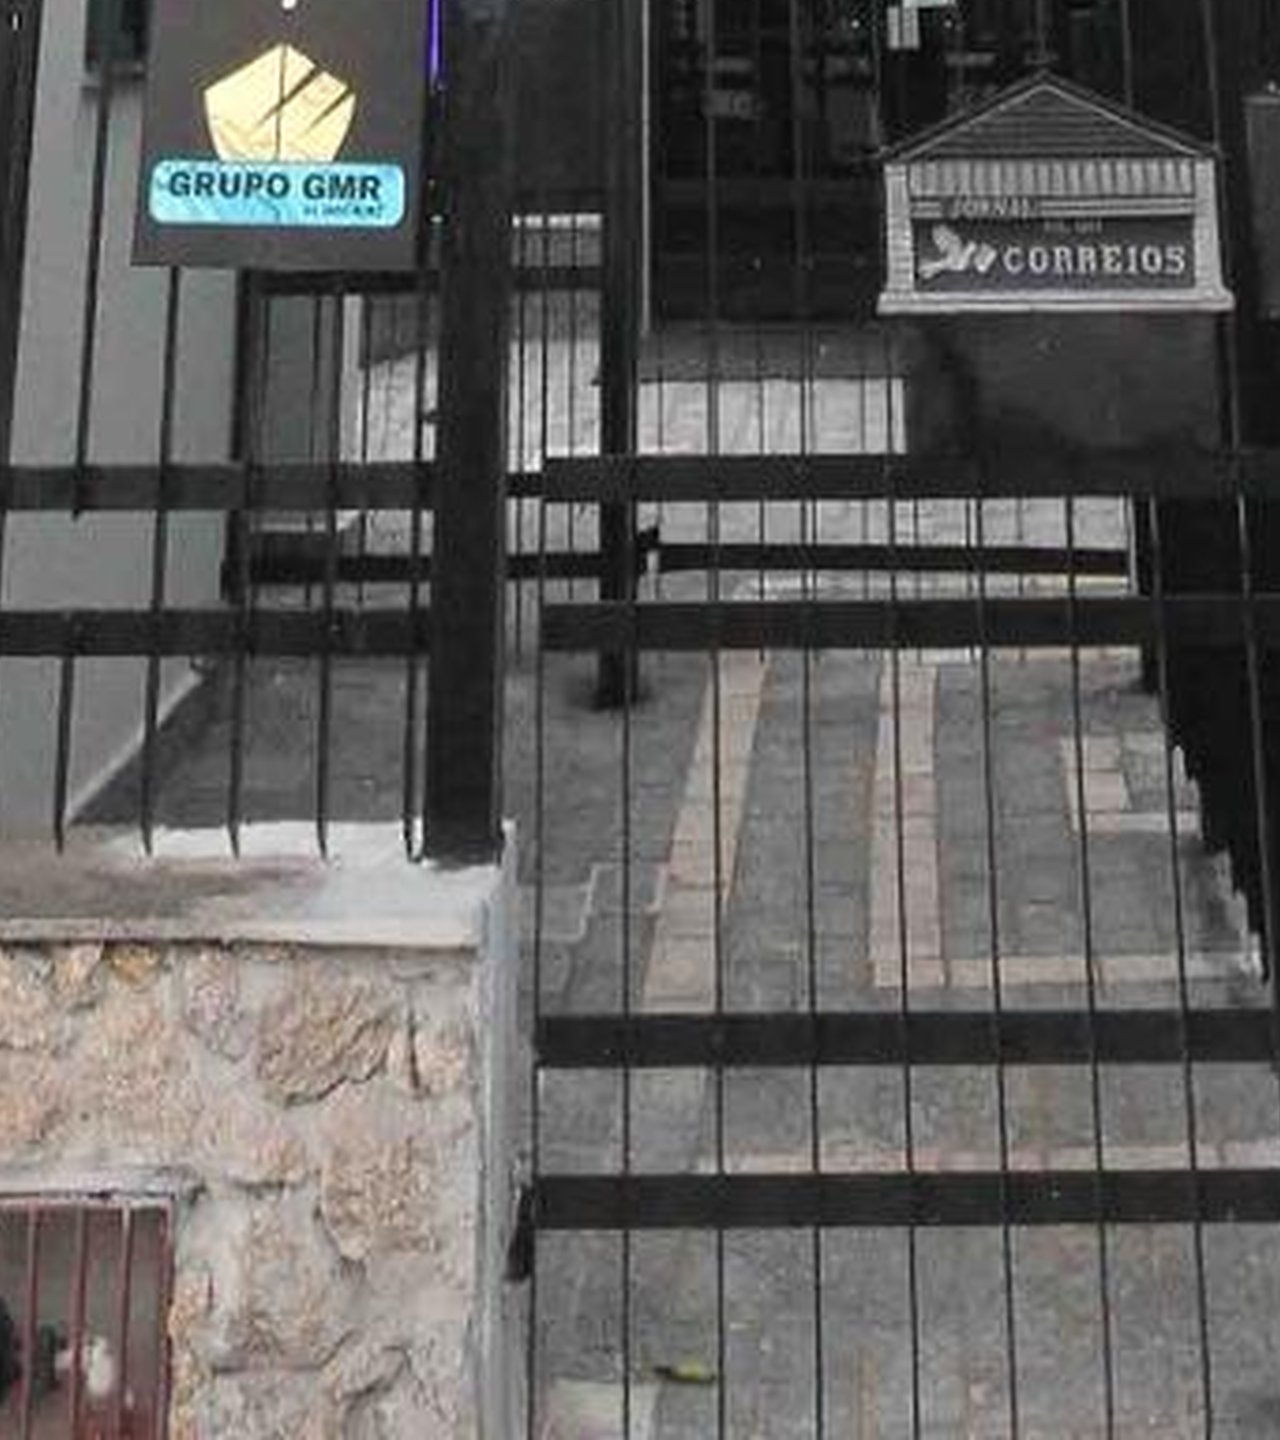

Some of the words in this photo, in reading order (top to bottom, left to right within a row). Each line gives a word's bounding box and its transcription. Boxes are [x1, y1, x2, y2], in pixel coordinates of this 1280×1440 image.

[169, 171, 291, 199] GRUPO
[302, 173, 382, 201] GMR
[1003, 245, 1186, 275] CORREIOS
